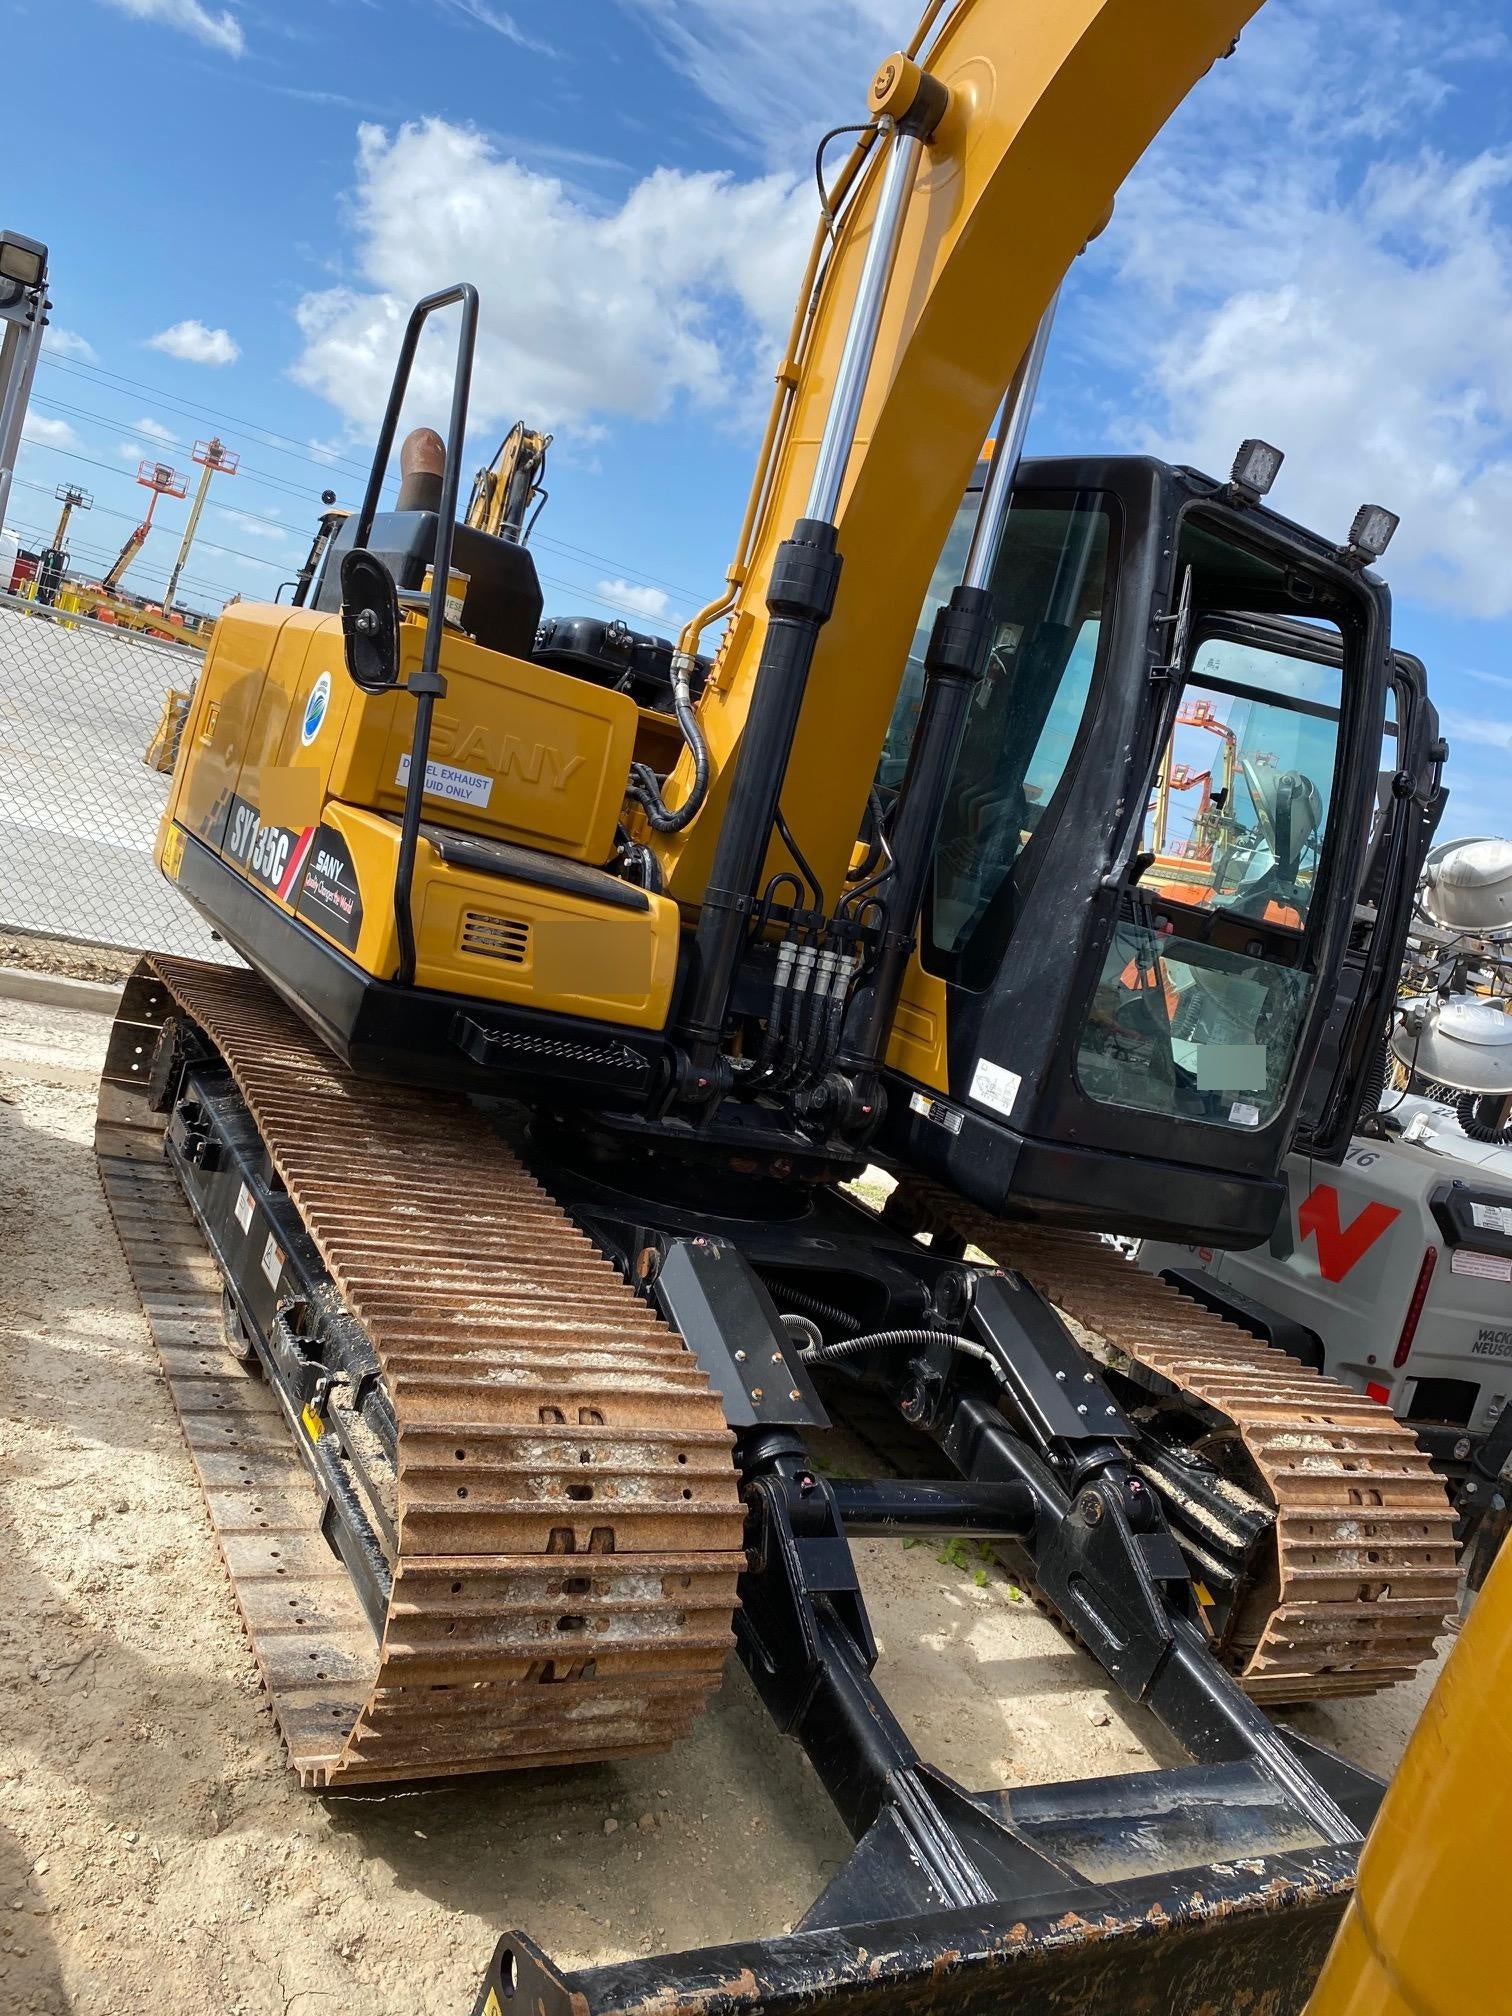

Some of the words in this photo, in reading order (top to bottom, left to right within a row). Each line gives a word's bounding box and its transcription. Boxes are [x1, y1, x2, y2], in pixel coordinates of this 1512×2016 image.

[416, 712, 587, 791] SANY
[440, 768, 490, 790] EXHAUST
[445, 784, 473, 800] ONLY
[230, 805, 289, 885] SY135C
[315, 850, 345, 882] SANY
